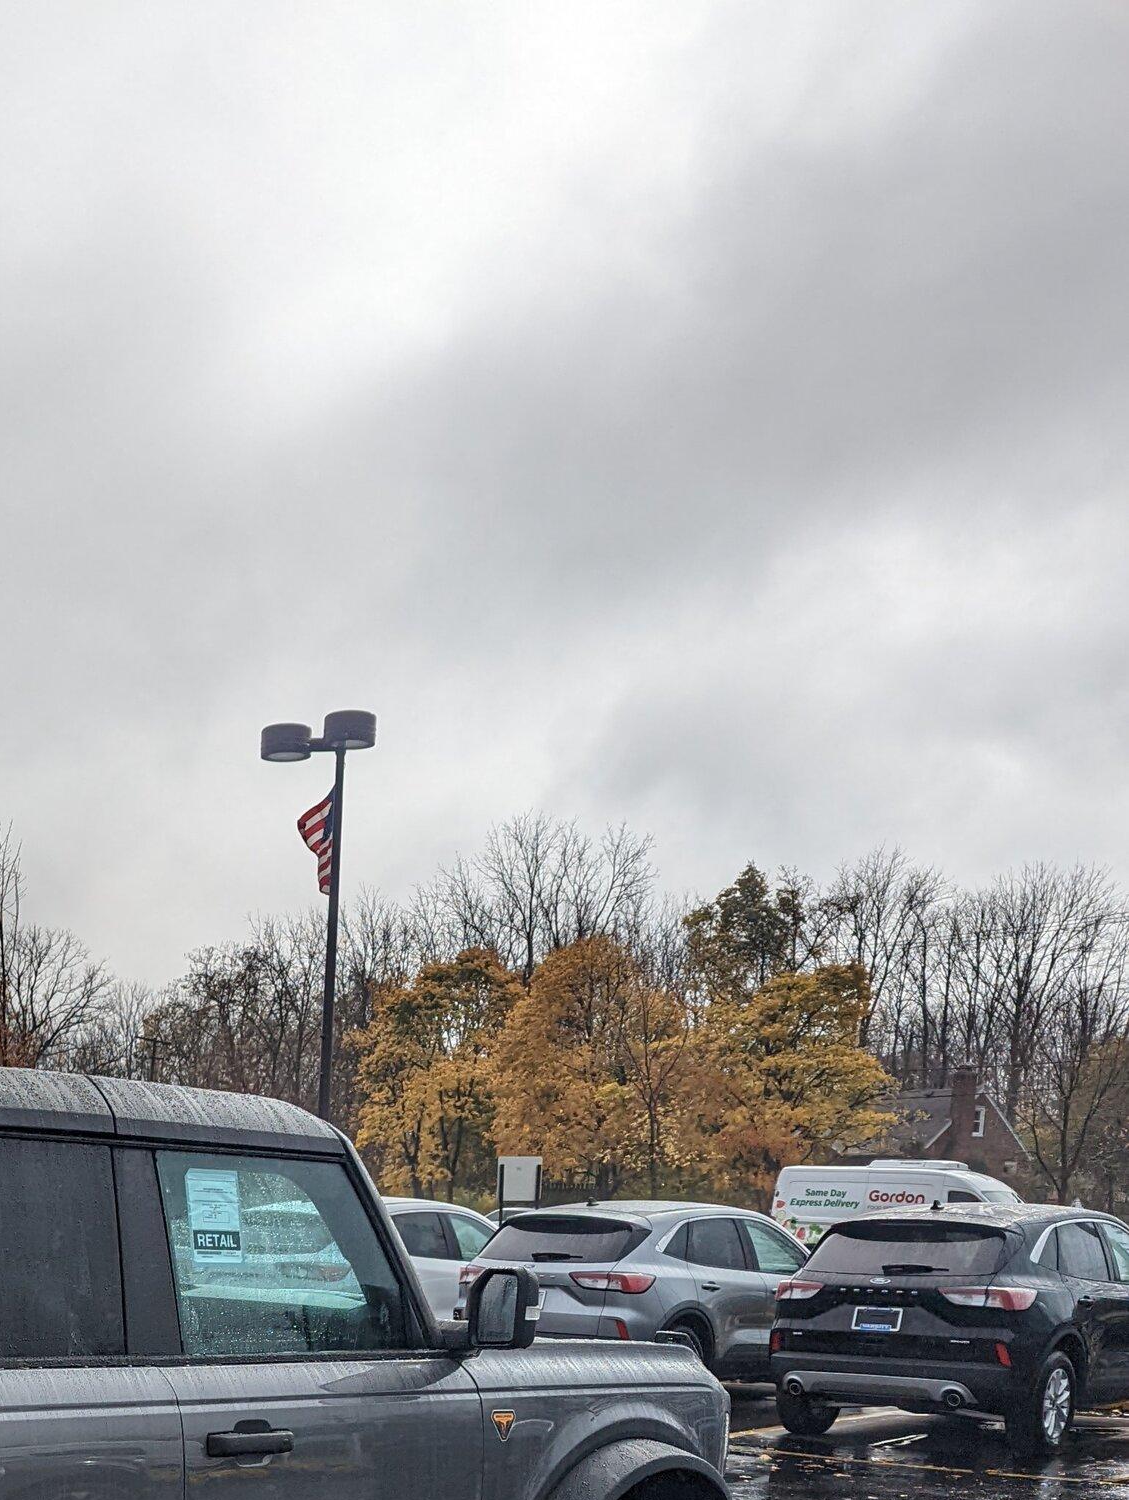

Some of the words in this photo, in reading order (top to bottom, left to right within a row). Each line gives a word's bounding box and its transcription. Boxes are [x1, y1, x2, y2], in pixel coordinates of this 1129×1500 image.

[805, 1188, 828, 1197] Same
[830, 1189, 848, 1199] Day
[869, 1189, 925, 1204] Gordon
[790, 1198, 821, 1208] Express
[824, 1199, 860, 1209] Delivery
[196, 1233, 237, 1248] RETAIL
